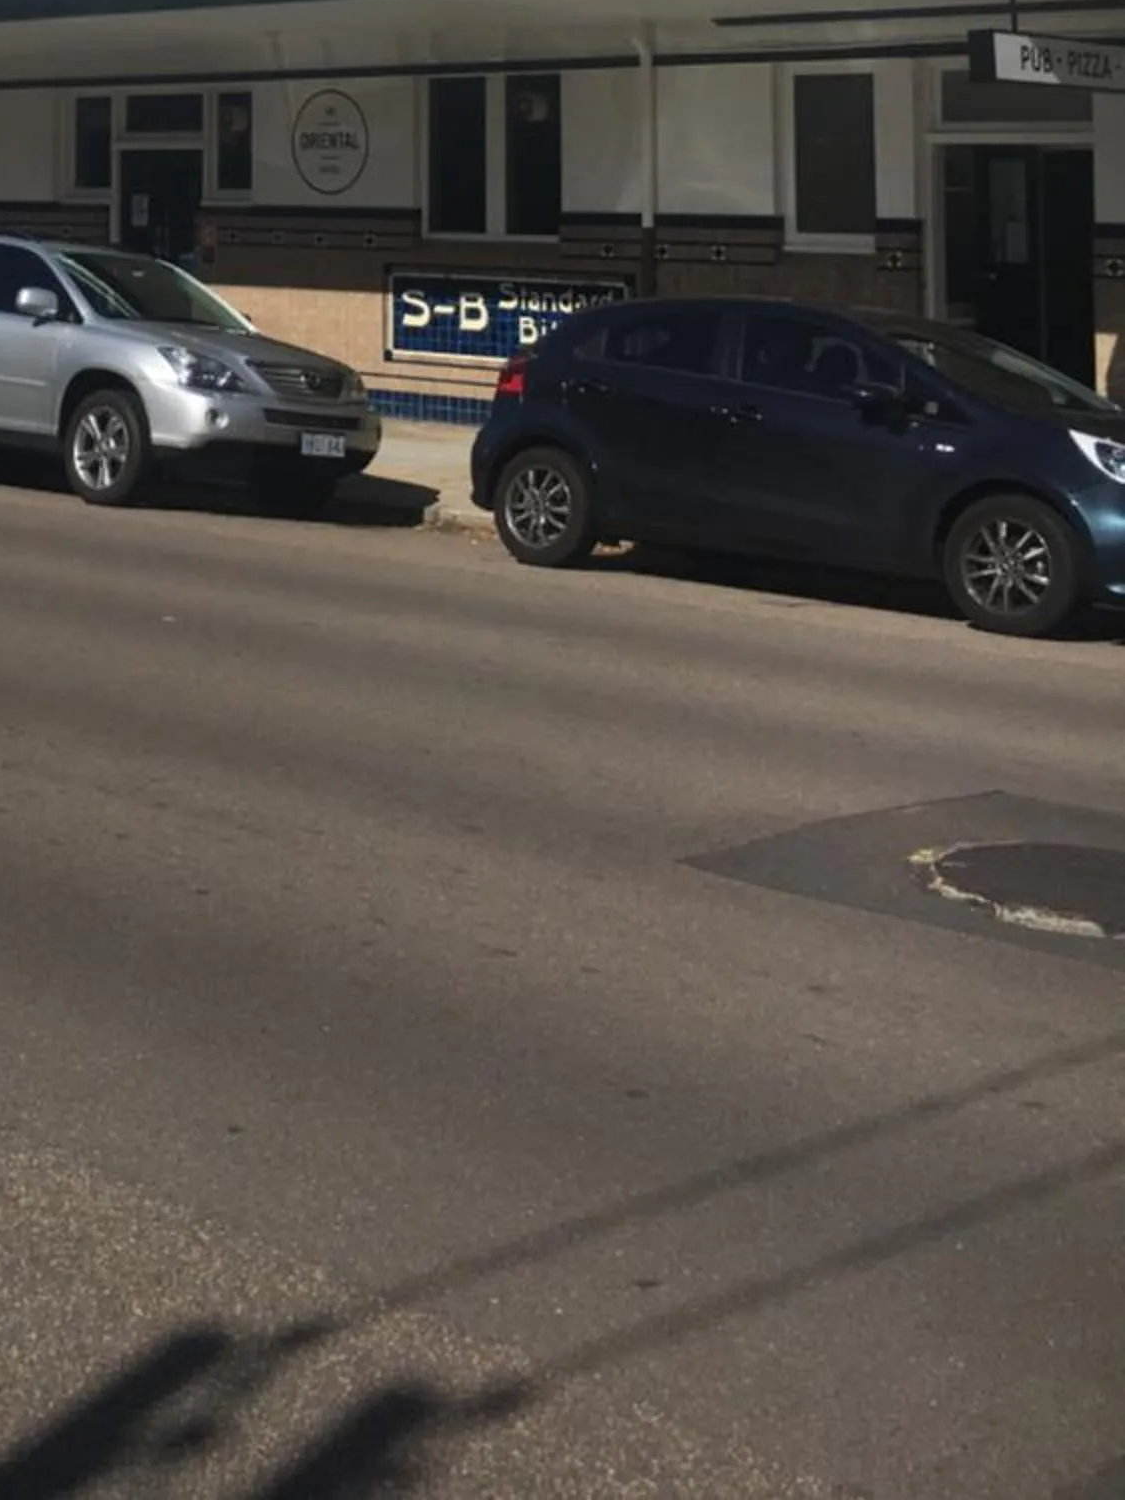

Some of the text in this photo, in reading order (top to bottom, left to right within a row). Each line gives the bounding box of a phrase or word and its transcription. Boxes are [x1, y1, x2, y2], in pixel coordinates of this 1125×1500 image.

[1019, 44, 1112, 79] PUB PIZZA
[401, 288, 489, 331] S-B
